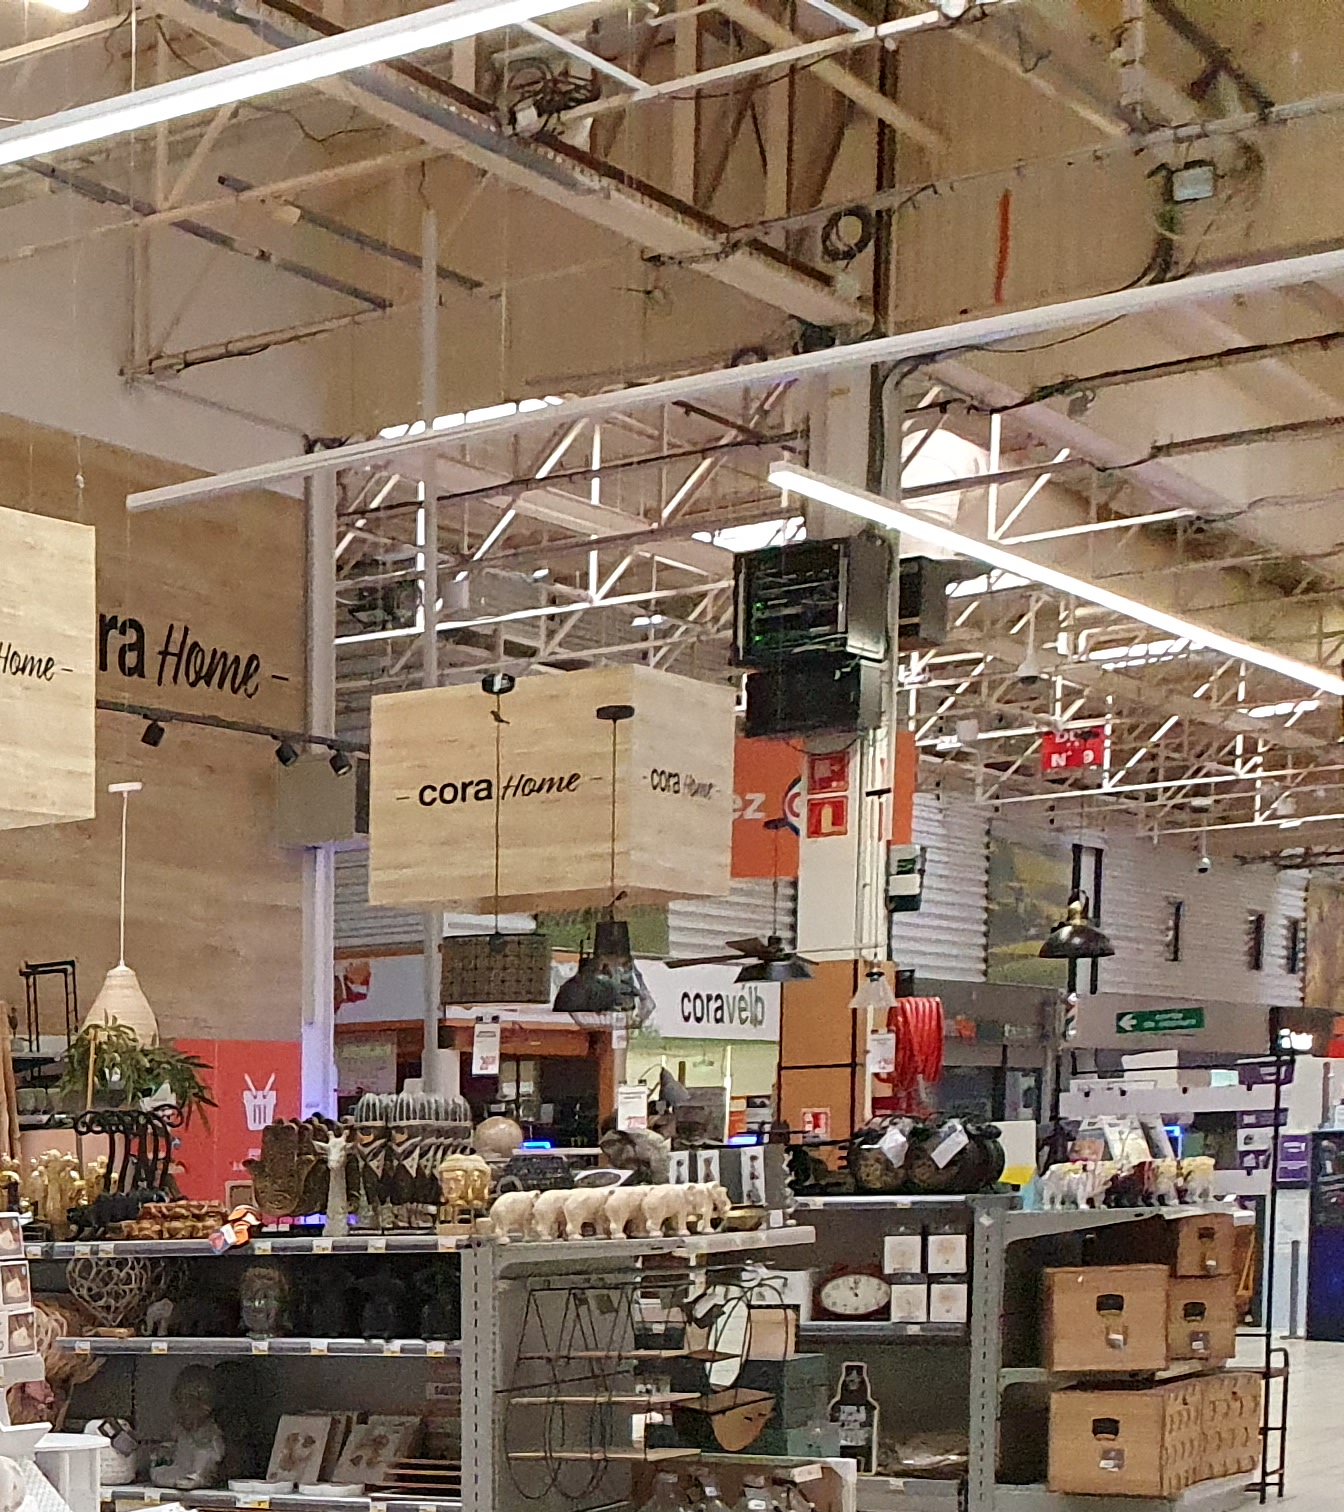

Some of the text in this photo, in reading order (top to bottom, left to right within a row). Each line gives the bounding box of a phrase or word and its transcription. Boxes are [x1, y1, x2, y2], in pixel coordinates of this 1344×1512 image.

[99, 613, 261, 699] ra Home
[418, 772, 581, 806] cora Home
[650, 768, 681, 794] cora
